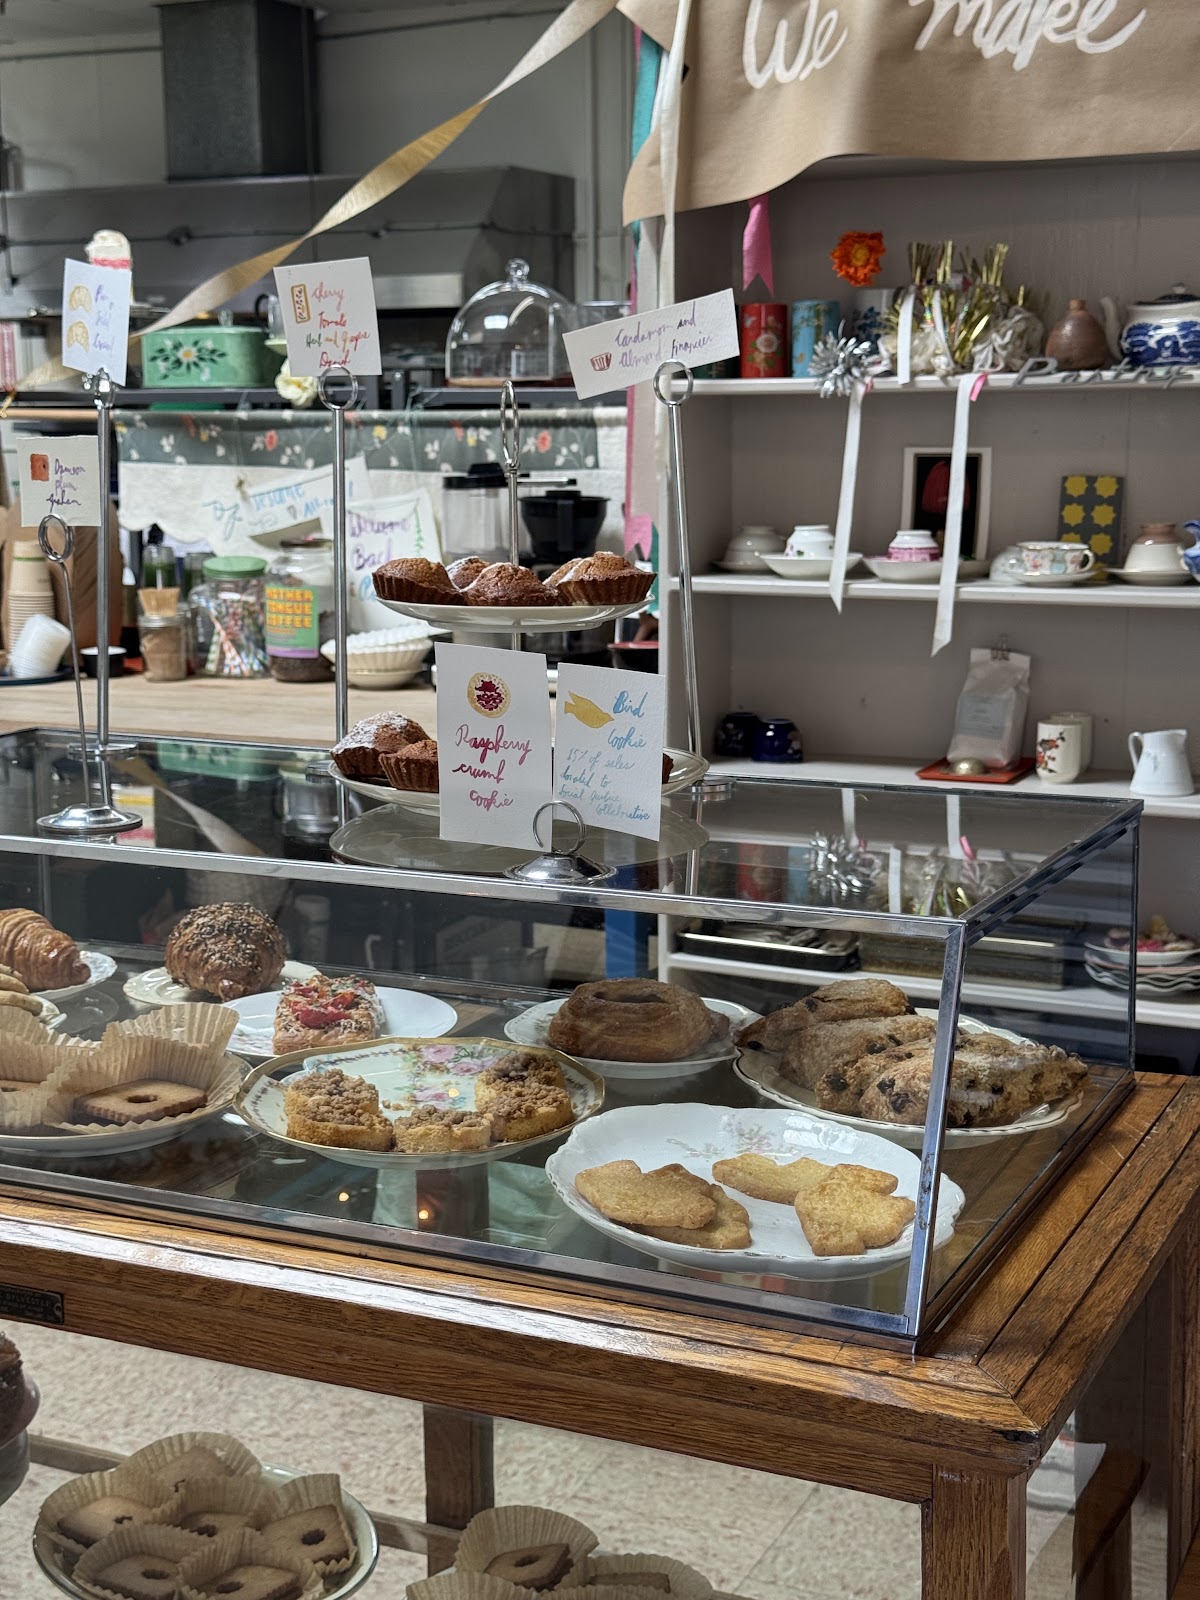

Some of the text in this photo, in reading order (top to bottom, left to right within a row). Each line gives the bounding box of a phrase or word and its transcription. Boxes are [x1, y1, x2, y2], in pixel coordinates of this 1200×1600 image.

[742, 0, 848, 89] We
[676, 301, 696, 330] and
[1009, 356, 1195, 390] Pastry
[612, 690, 649, 718] Bird
[455, 723, 533, 766] Raspberry
[452, 759, 506, 784] crumb
[567, 747, 635, 771] 15% of sales
[560, 765, 612, 789] donated to
